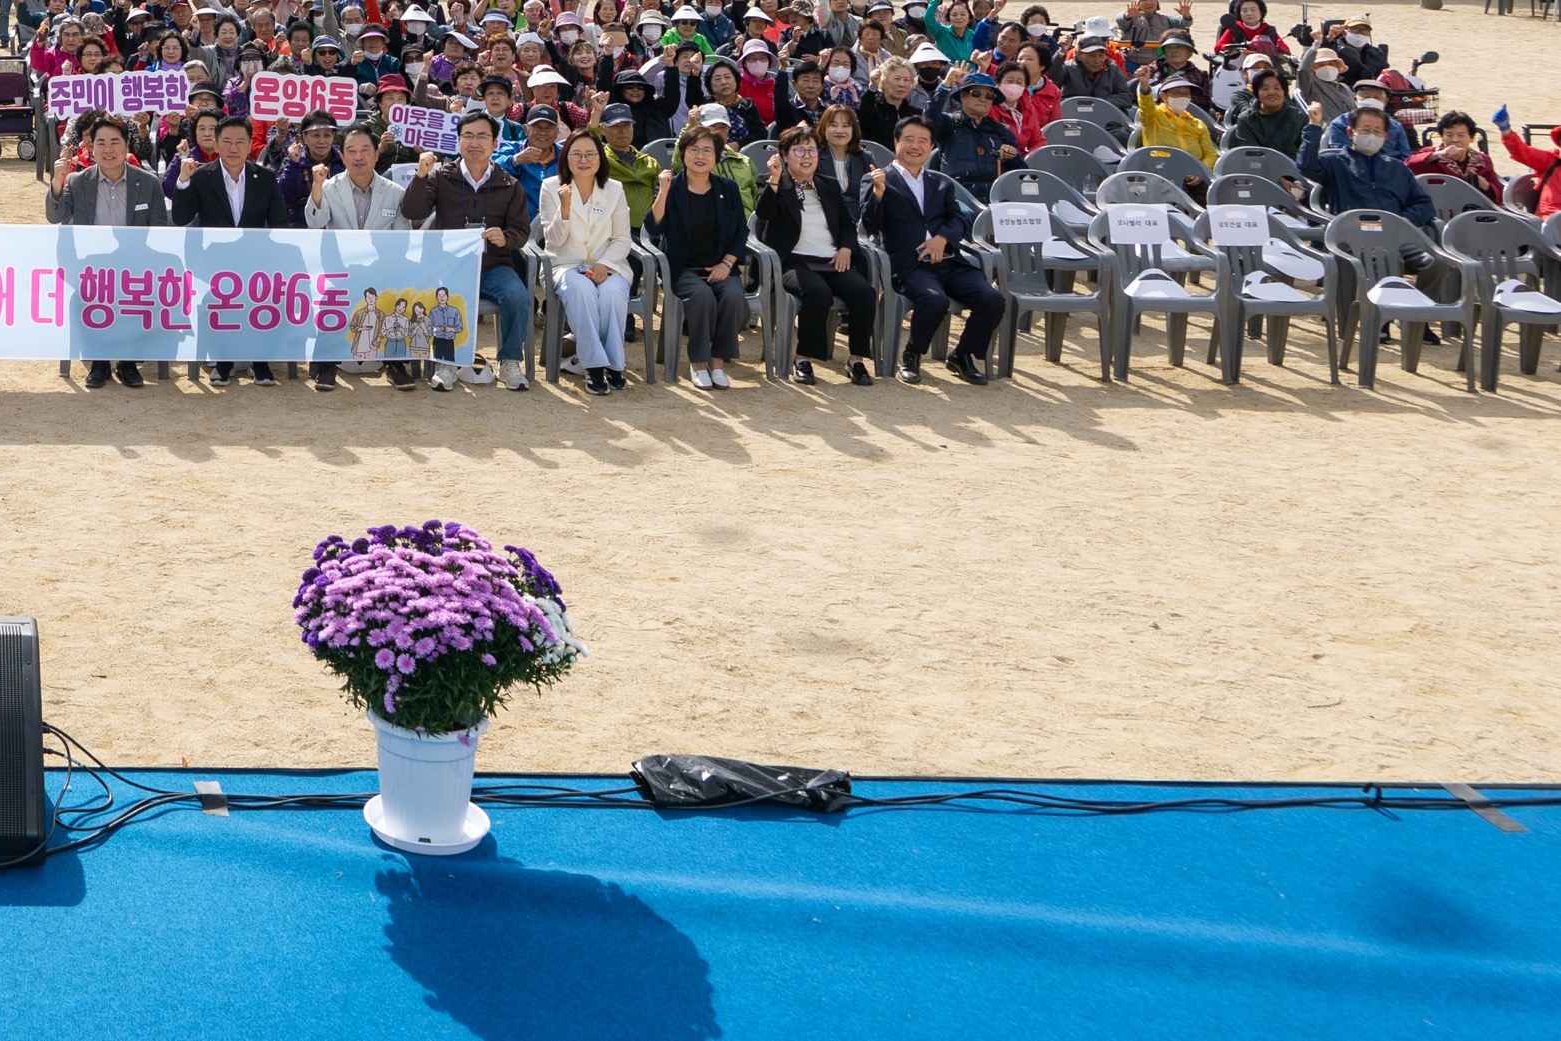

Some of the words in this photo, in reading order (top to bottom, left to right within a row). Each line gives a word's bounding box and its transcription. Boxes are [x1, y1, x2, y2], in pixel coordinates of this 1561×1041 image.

[50, 76, 115, 116] 주민이
[120, 74, 188, 112] 행복한
[253, 76, 354, 121] 온양6동
[392, 106, 445, 130] 이웃을
[403, 127, 458, 152] 마음을
[30, 266, 66, 329] 더
[78, 264, 196, 332] 행복한
[205, 269, 352, 333] 온양6동
